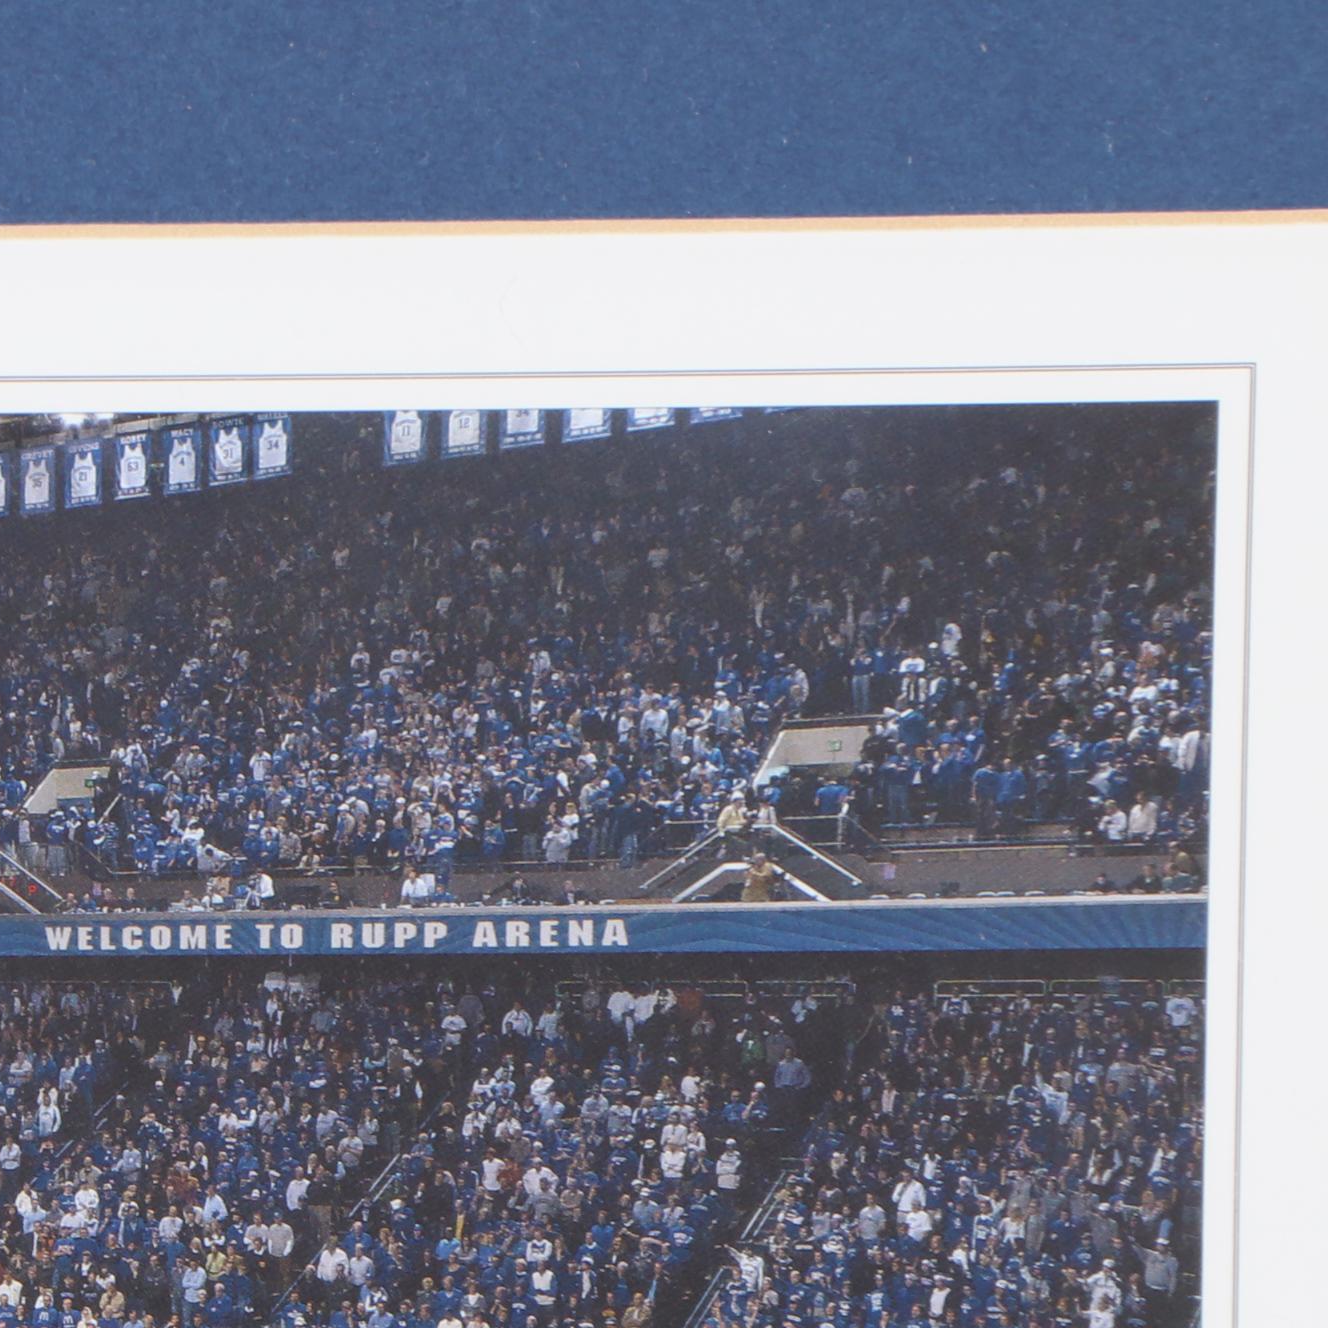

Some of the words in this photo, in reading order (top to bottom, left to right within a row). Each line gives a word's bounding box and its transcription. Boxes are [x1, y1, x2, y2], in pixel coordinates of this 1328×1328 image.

[459, 417, 470, 429] 12
[400, 425, 411, 437] 11
[267, 439, 279, 450] 34
[179, 456, 185, 467] 4
[45, 924, 232, 952] WELCOME
[256, 923, 304, 950] TO
[331, 921, 448, 949] RUPP
[473, 919, 630, 948] ARENA
